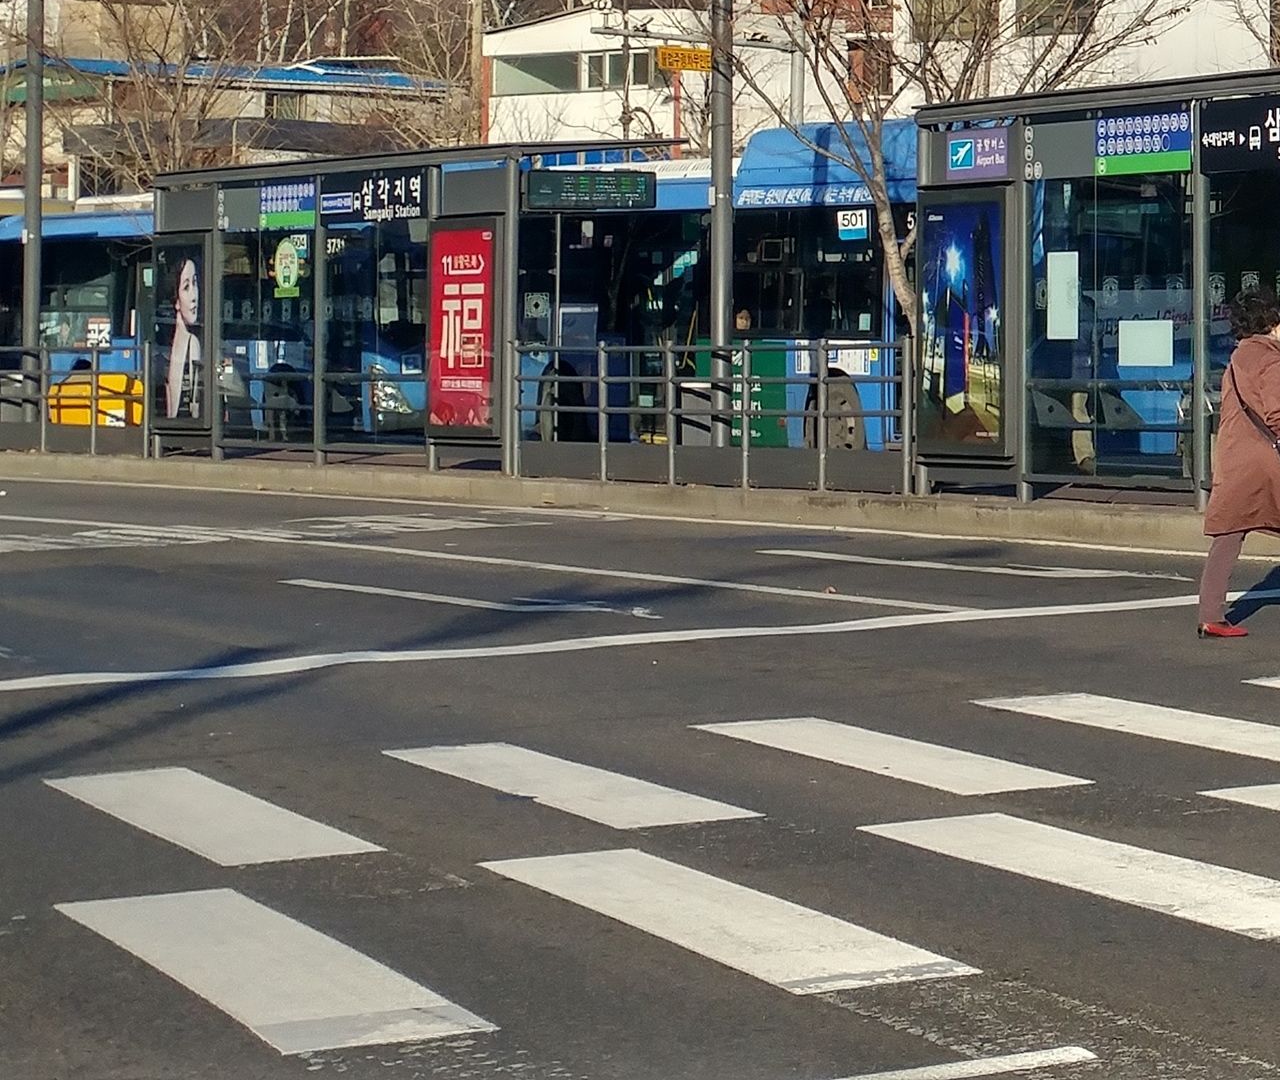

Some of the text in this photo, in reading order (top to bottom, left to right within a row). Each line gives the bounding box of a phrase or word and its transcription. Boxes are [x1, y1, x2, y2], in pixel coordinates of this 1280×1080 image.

[976, 154, 996, 166] Airport
[361, 174, 421, 209] 삼각지역
[363, 203, 421, 222] Samgakji Station
[841, 213, 865, 227] 501
